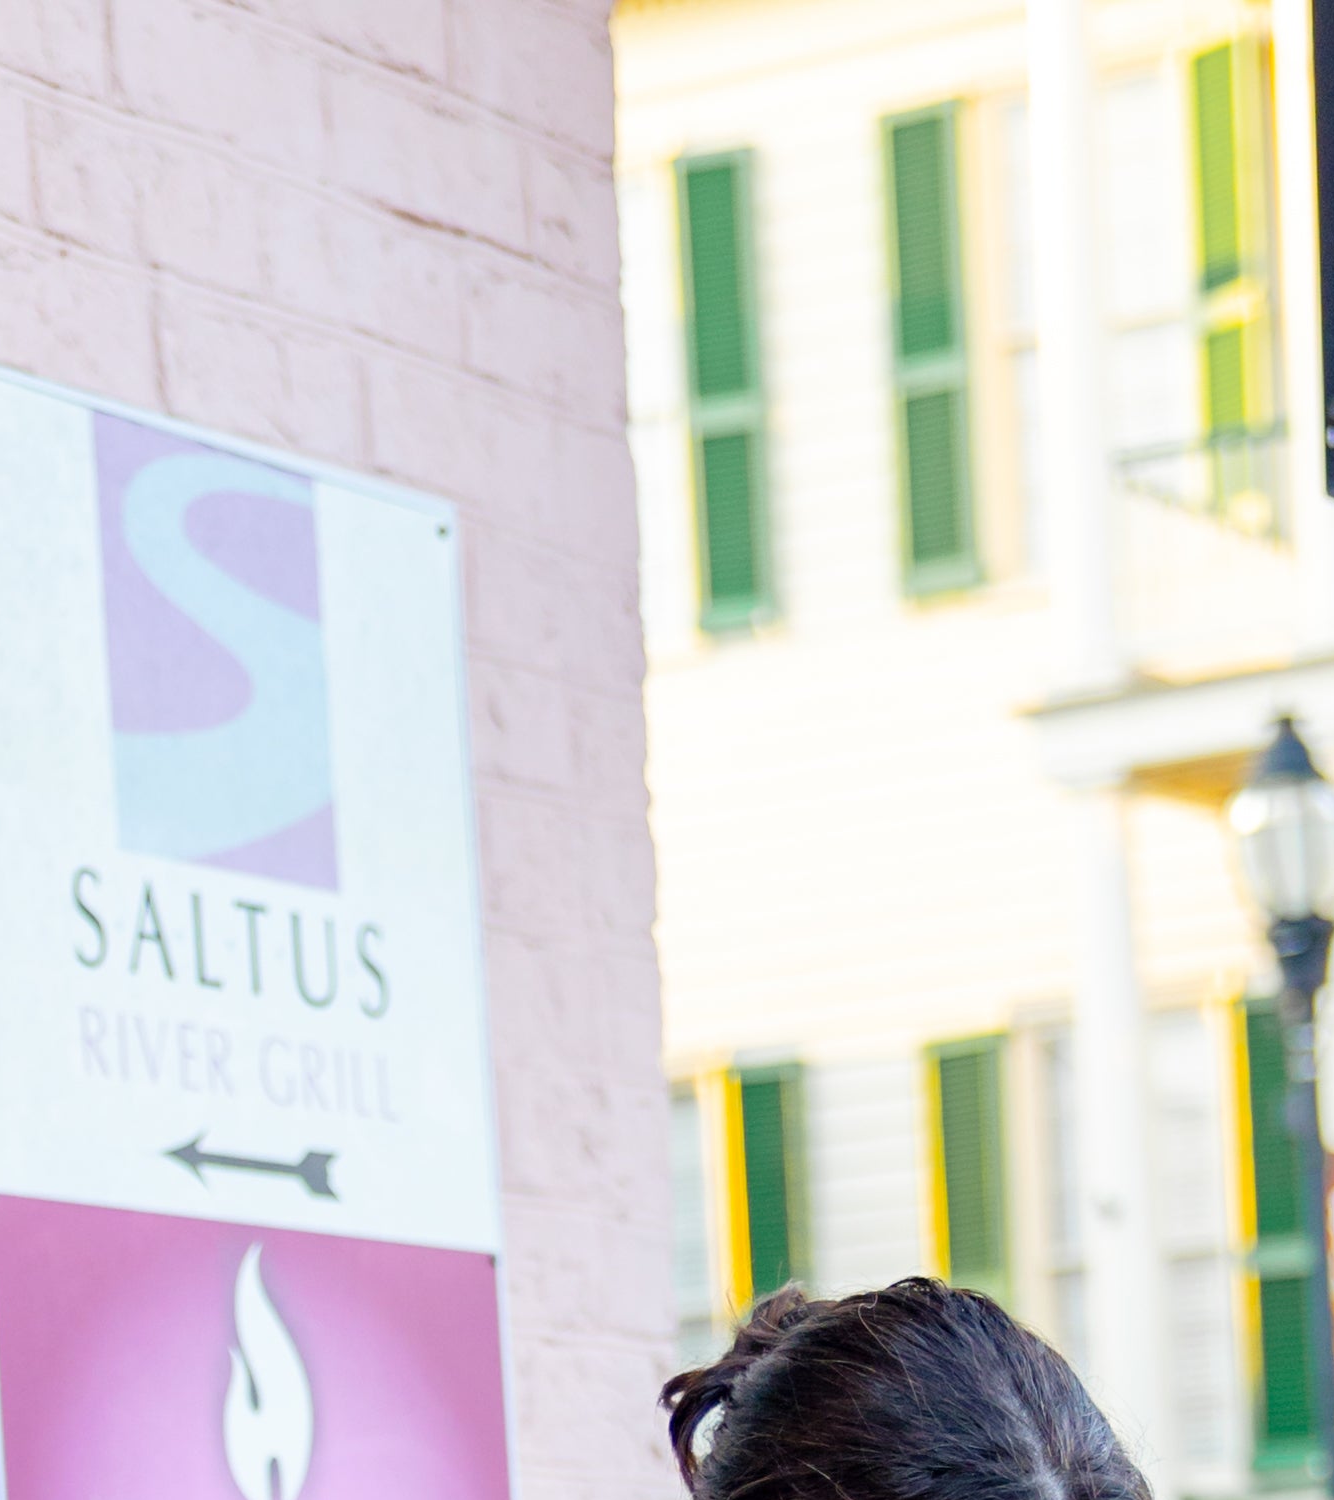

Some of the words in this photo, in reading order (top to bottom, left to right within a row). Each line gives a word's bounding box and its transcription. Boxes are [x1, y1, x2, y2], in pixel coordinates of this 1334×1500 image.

[72, 868, 389, 1019] SALTUS
[79, 1007, 234, 1098] RIVER
[259, 1038, 401, 1123] GRILL
